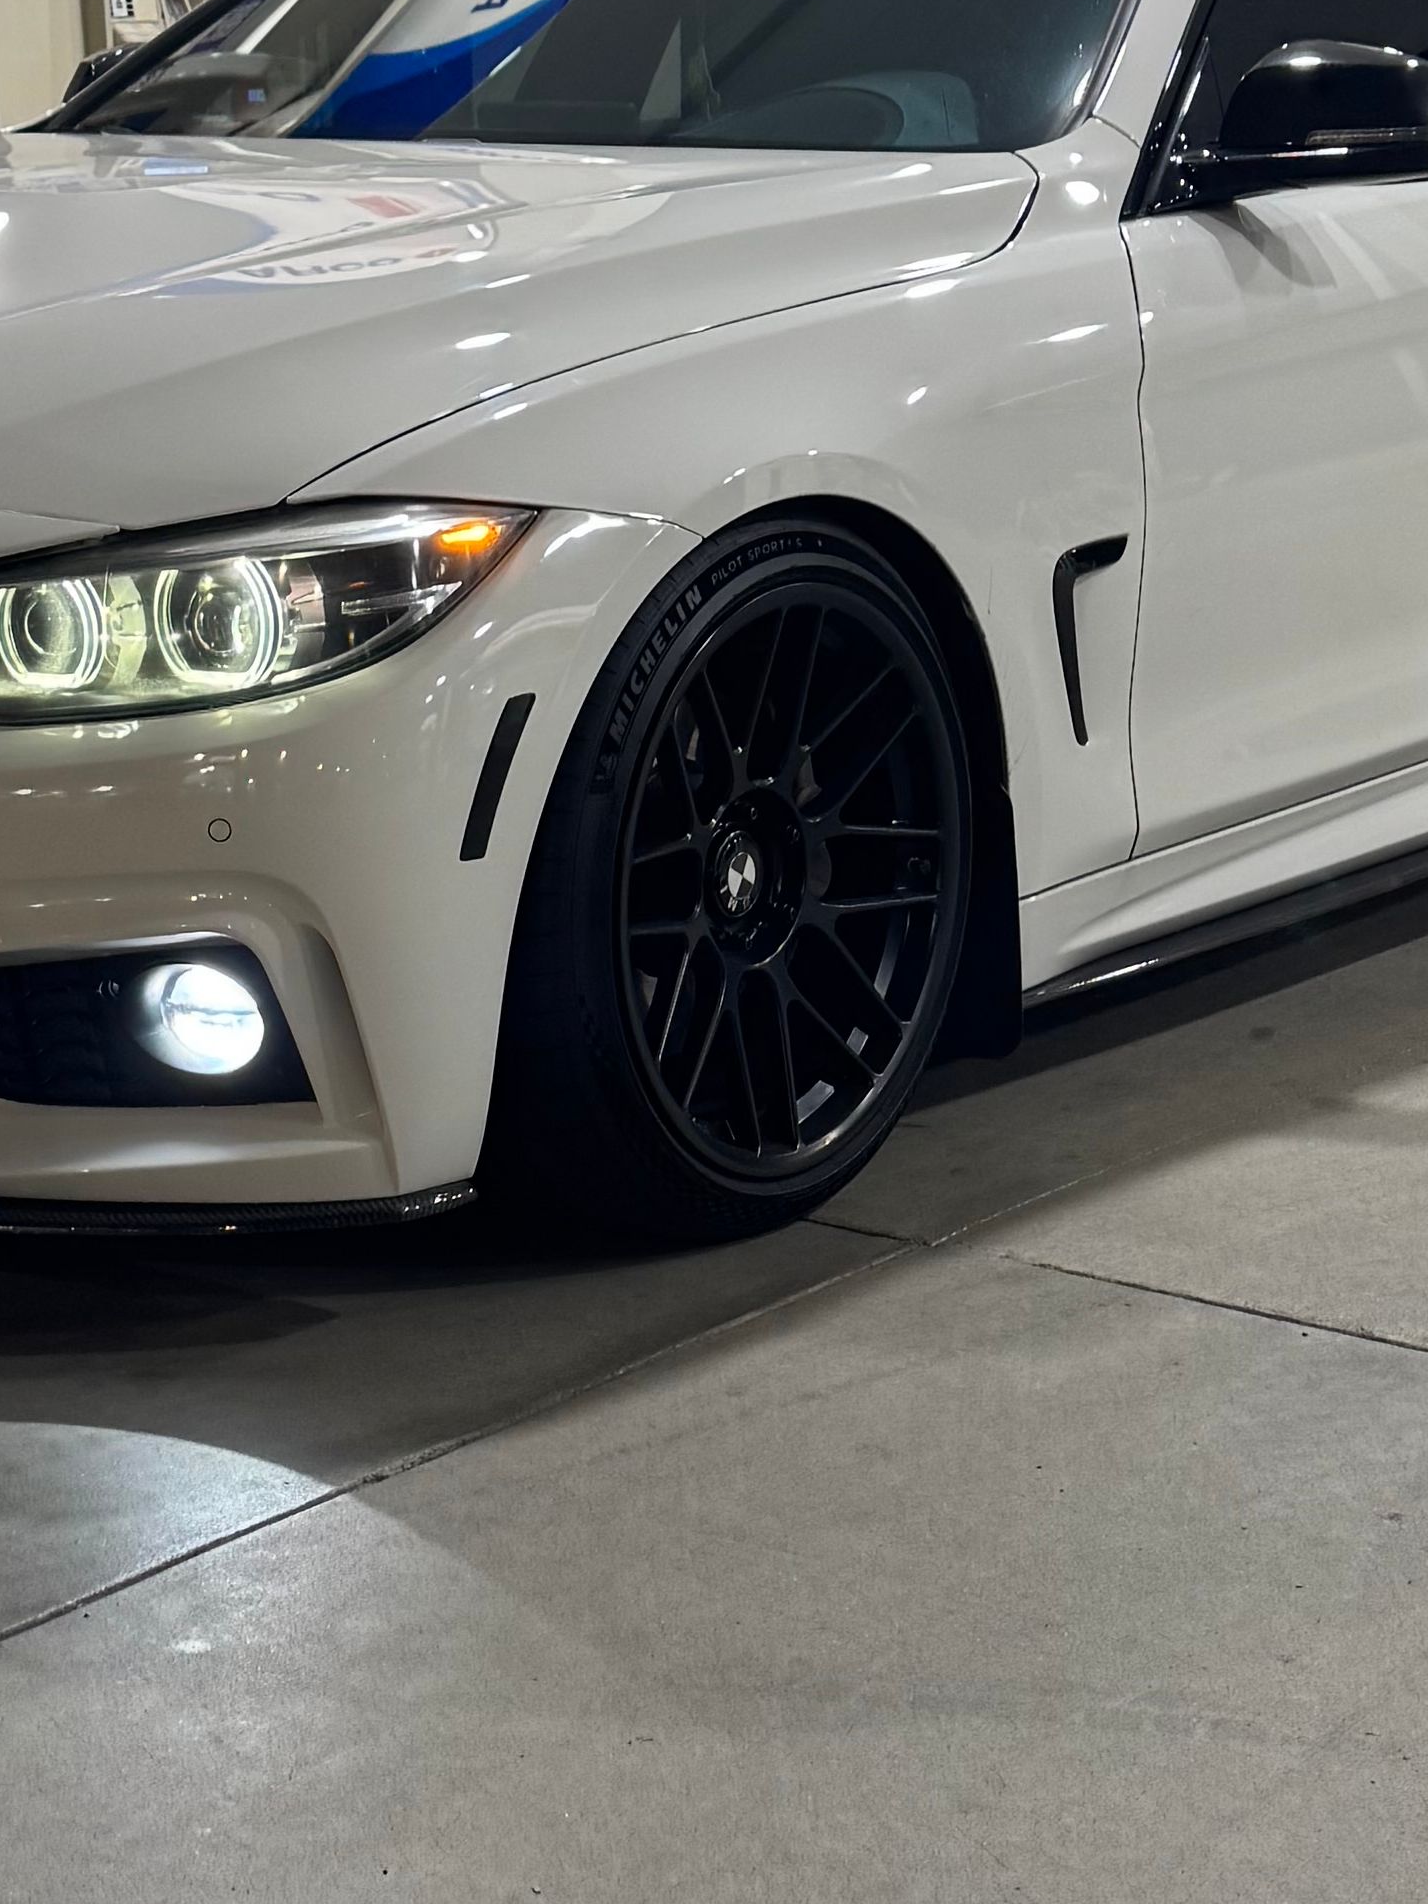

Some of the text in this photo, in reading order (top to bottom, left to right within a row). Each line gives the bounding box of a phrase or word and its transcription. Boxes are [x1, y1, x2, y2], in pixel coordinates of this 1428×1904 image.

[609, 584, 703, 746] MICHELIN
[711, 555, 743, 586] PILOT
[746, 538, 785, 562] SPORT
